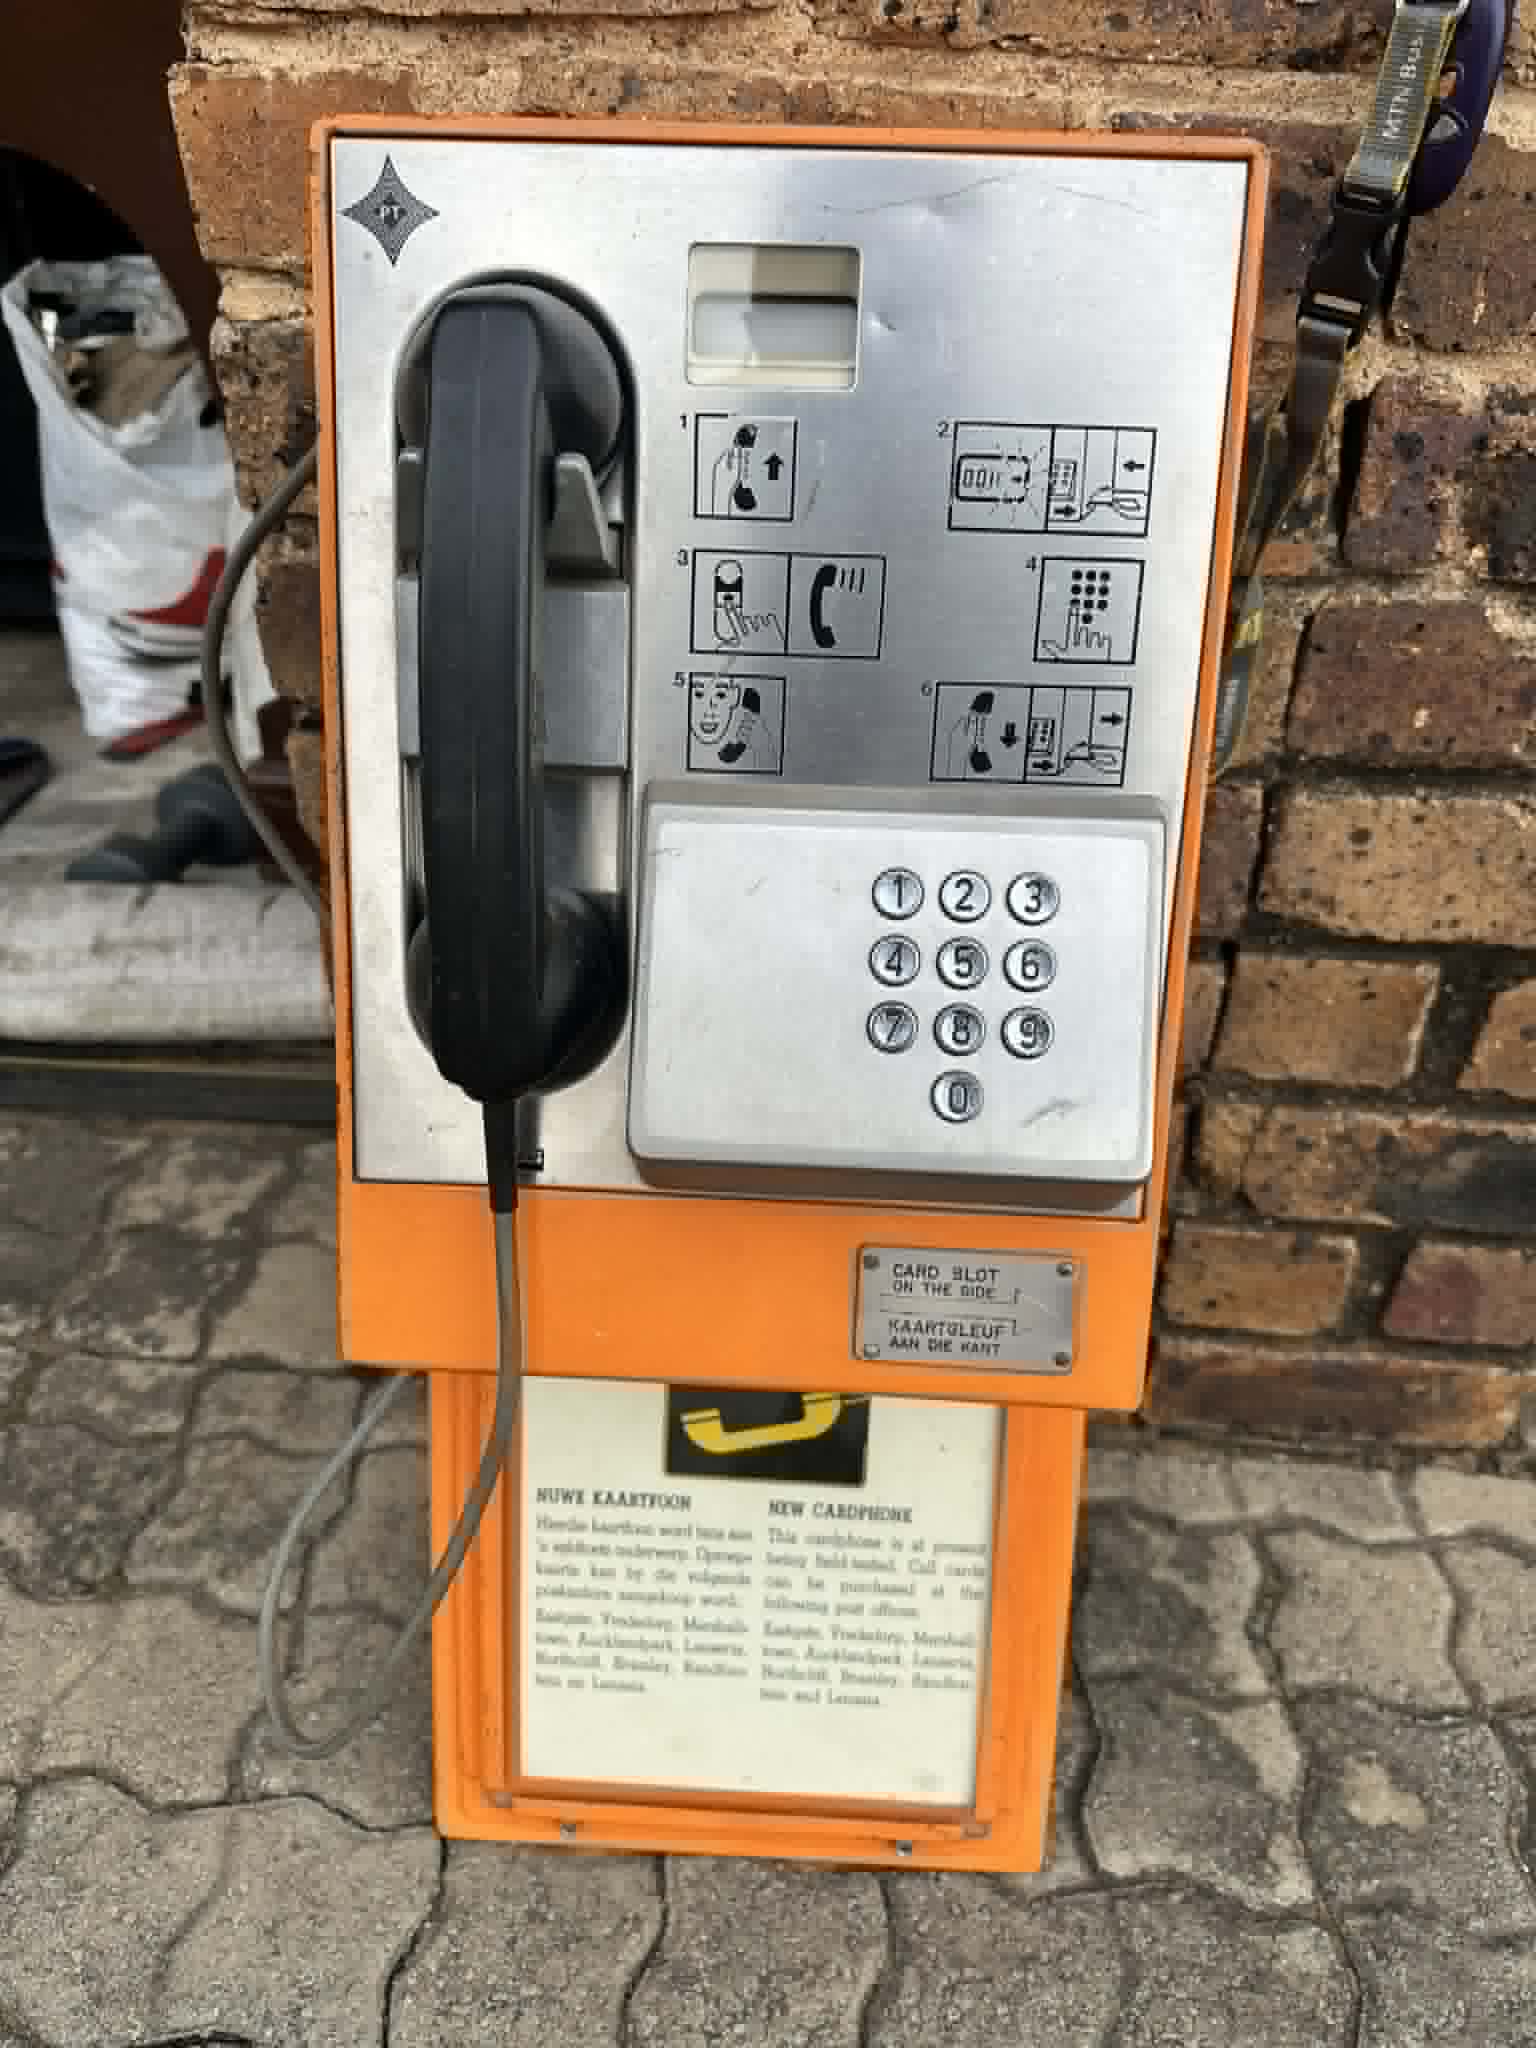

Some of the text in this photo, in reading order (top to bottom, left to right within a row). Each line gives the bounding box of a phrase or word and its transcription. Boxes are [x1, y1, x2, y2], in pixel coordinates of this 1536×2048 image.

[680, 414, 688, 429] 1
[936, 422, 949, 438] 2
[676, 551, 688, 566] 3
[1025, 557, 1037, 572] 4
[674, 672, 686, 687] 5
[921, 683, 932, 697] 6
[893, 874, 1042, 913] 1 2 3
[885, 943, 1040, 981] 4 5 6
[884, 1008, 1037, 1049] 7 8 9
[949, 1081, 968, 1114] 0
[892, 1263, 1001, 1283] CARD SLOT
[892, 1280, 914, 1294] ON
[923, 1281, 953, 1297] THE
[888, 1336, 920, 1353] AAN
[927, 1338, 953, 1354] DIE
[536, 1488, 692, 1511] NUWE KAARTFOON
[768, 1500, 913, 1522] NEW CARDPHONE
